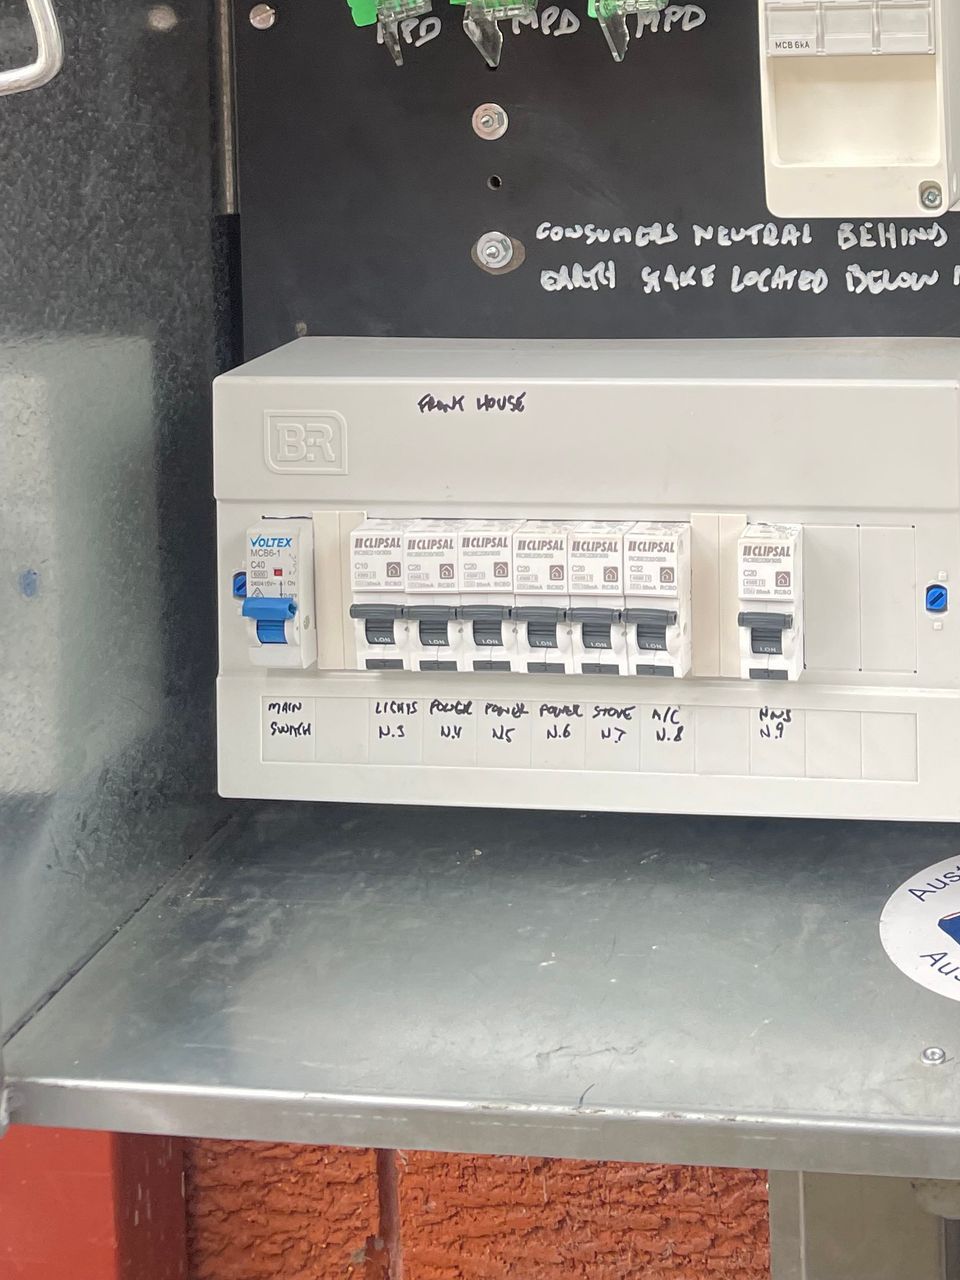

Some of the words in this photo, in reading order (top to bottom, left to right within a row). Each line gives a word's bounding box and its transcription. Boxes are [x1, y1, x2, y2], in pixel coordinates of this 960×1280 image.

[795, 41, 810, 49] 6kA
[535, 221, 679, 247] CONSUMERS
[693, 222, 812, 247] NEUTRAL
[837, 221, 948, 250] BEHIND
[540, 260, 616, 292] EARTH
[641, 264, 716, 294] STAKE
[731, 265, 828, 294] LOCATED
[845, 263, 939, 294] BELOW
[476, 391, 527, 413] HOUSE
[250, 534, 293, 547] VOLTEX
[364, 537, 401, 549] CLIPSAL
[417, 539, 454, 550] CLIPSAL
[471, 537, 508, 548] CLIPSAL
[527, 540, 564, 551] CLIPSAL
[581, 541, 618, 553] CLIPSAL
[250, 549, 280, 557] MCB6-1
[637, 542, 675, 553] CLIPSAL
[752, 546, 791, 557] CLIPSAL
[250, 560, 266, 569] C40
[268, 701, 302, 714] MAIN
[430, 699, 473, 716] POWER
[485, 702, 529, 718] POWER
[539, 703, 584, 718] POWER
[592, 705, 636, 721] STOVE
[652, 705, 681, 725] A/C
[656, 725, 685, 742] N.8
